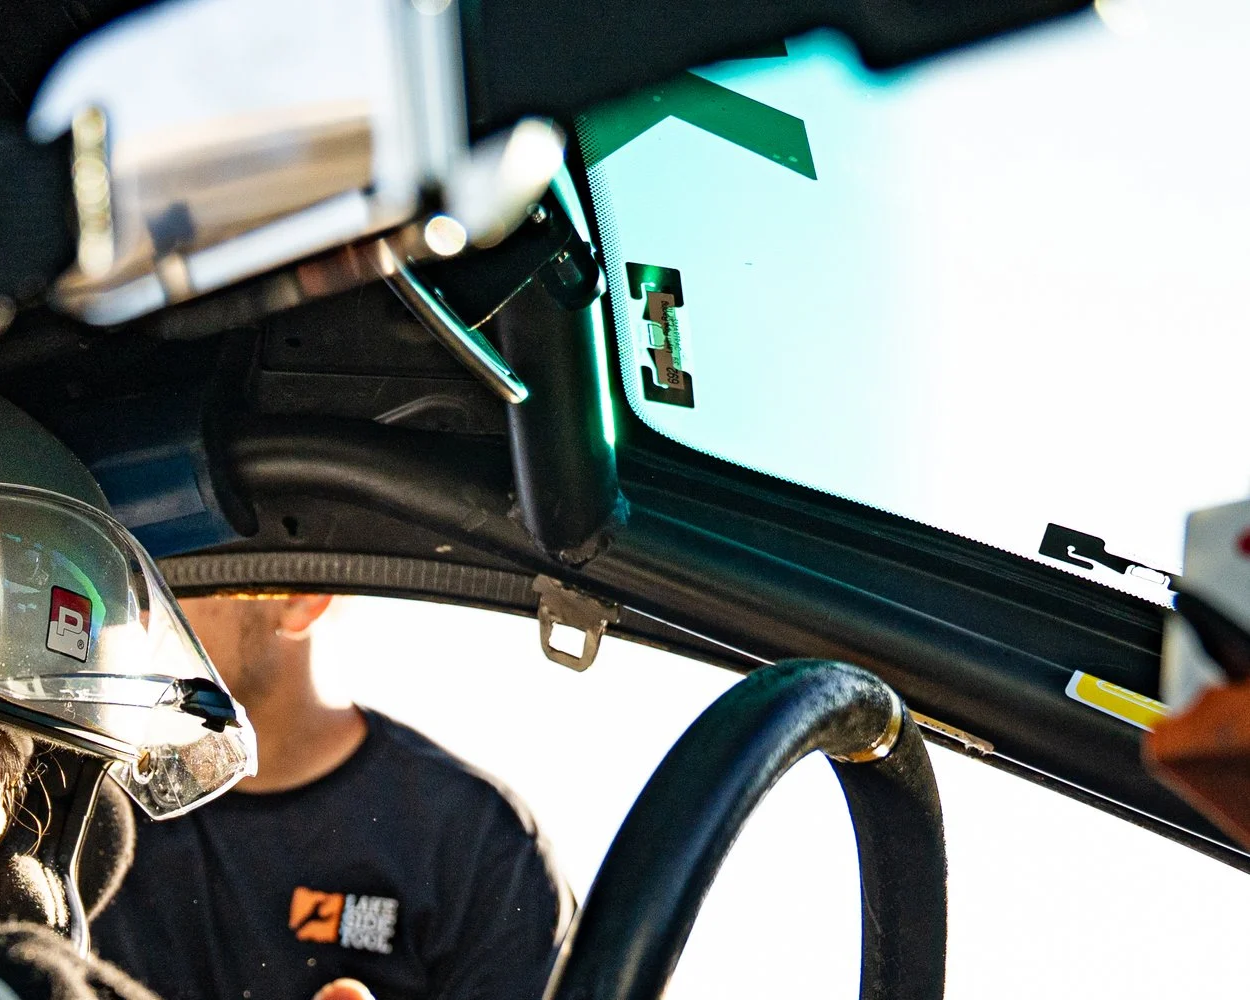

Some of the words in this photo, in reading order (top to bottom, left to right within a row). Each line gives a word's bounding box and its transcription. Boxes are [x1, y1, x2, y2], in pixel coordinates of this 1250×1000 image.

[666, 367, 680, 384] 692
[345, 893, 399, 918] LAKE
[342, 909, 397, 937] SIDE
[340, 927, 393, 954] TOOL
